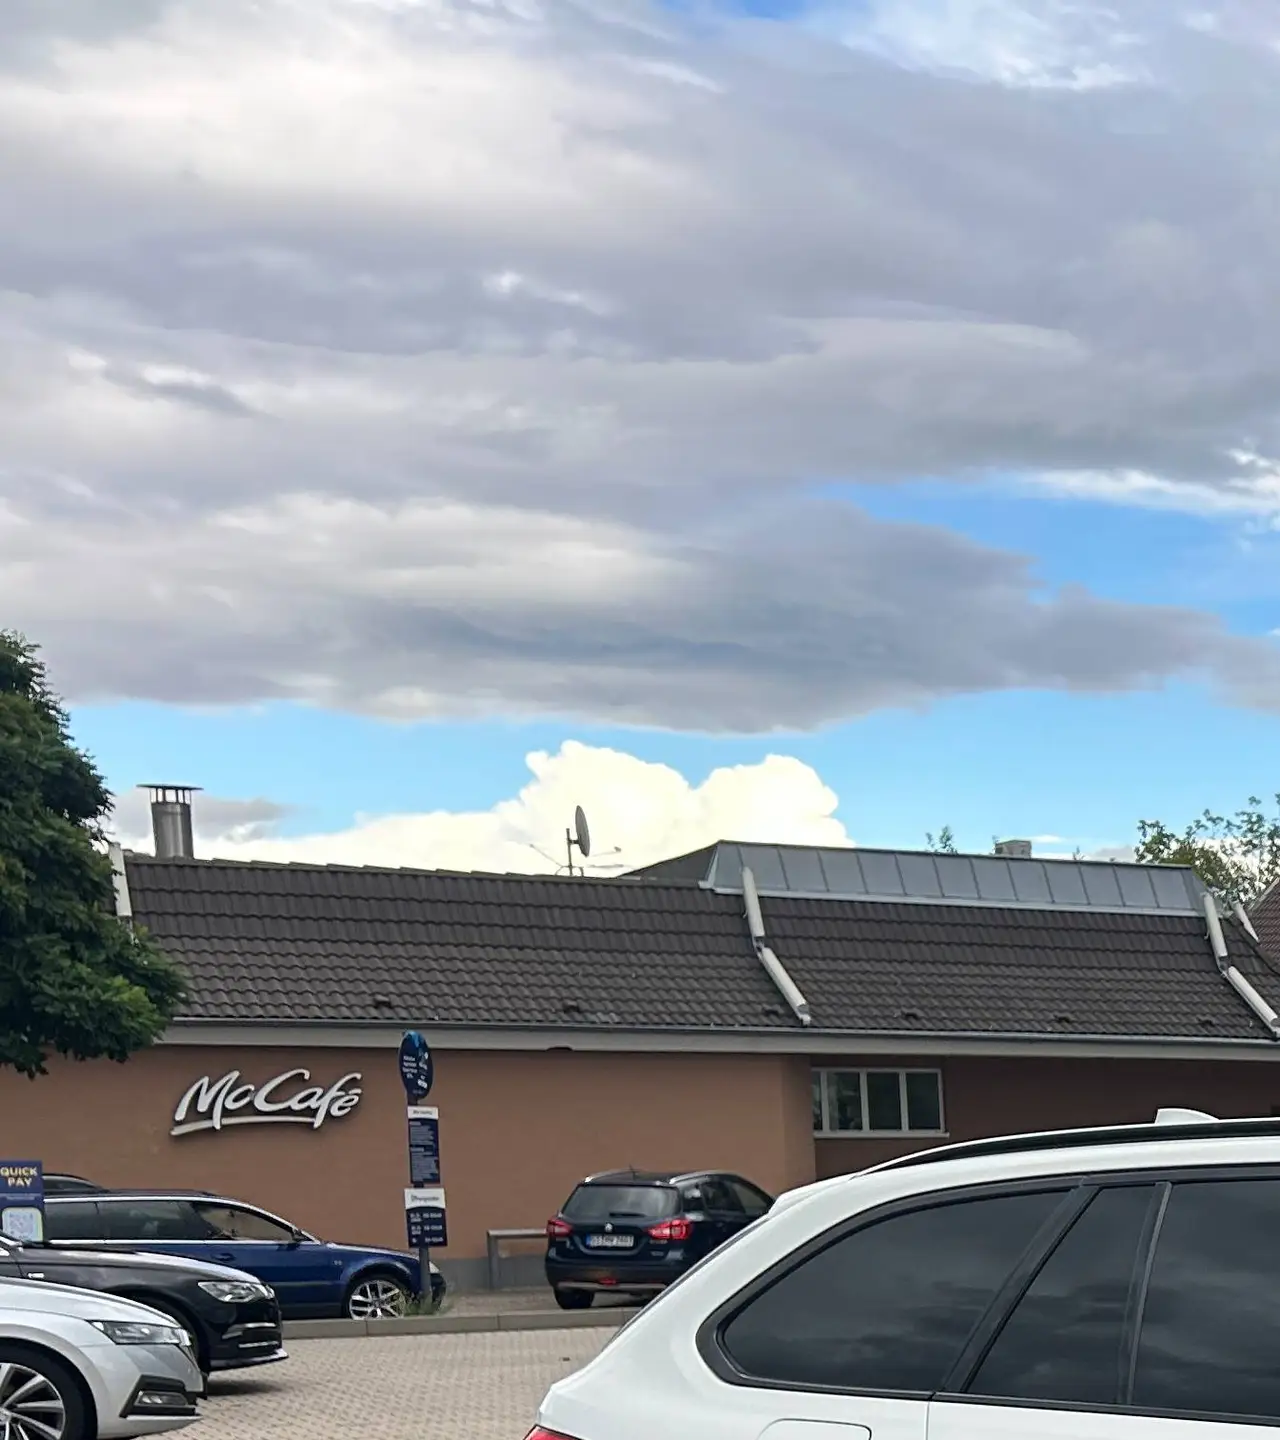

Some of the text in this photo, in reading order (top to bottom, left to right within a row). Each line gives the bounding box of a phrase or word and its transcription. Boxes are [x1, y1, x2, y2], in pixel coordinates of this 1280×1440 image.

[174, 1068, 362, 1130] McCafé
[0, 1166, 38, 1177] QUICK
[8, 1177, 33, 1187] PAY
